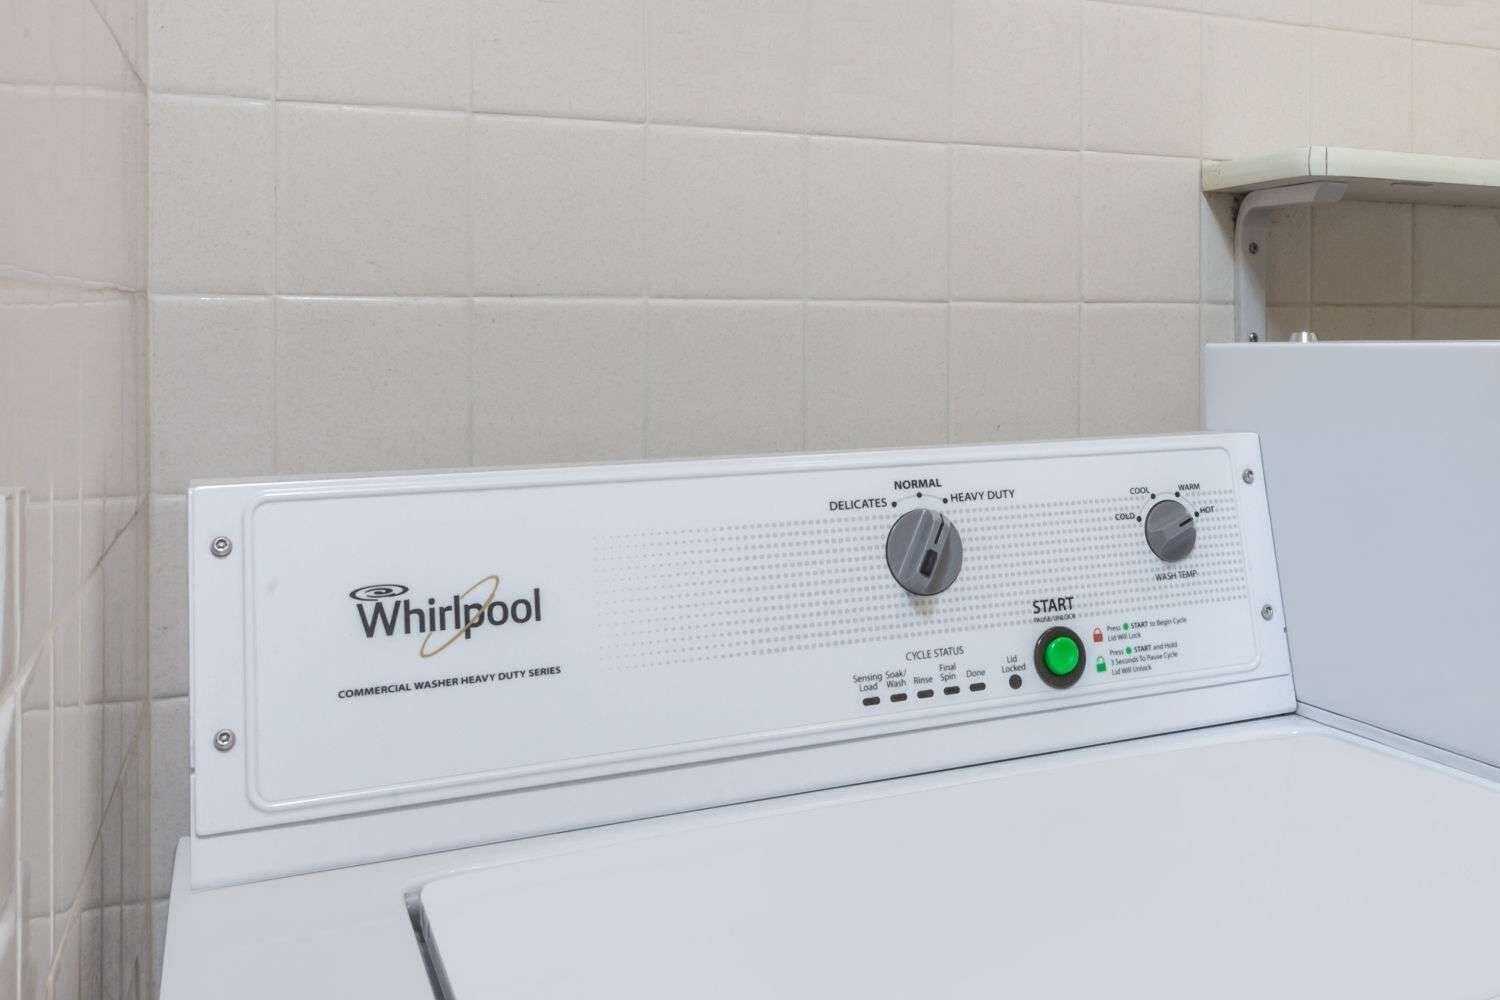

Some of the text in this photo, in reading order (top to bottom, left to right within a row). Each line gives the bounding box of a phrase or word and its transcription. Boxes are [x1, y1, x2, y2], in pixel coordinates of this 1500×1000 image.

[894, 478, 942, 490] NORMAL
[1178, 483, 1200, 491] WARM
[950, 489, 1015, 503] HEAVY DUTY
[1129, 487, 1150, 495] COOL
[829, 498, 888, 511] DELICATES
[1115, 512, 1135, 521] COLD
[1155, 571, 1177, 581] WASH
[1032, 597, 1075, 614] START
[356, 588, 542, 640] Whirlpool
[1131, 620, 1148, 630] START
[1134, 644, 1152, 653] START
[905, 646, 965, 662] CYCLE STATUS
[1006, 655, 1018, 664] Lid
[939, 662, 957, 671] Final
[1001, 663, 1026, 673] Locked
[852, 672, 883, 683] Sensing
[940, 672, 957, 683] Spin
[966, 669, 985, 678] Done
[338, 666, 561, 699] COMMERCIAL WASHER HEAVY DUTY SERIES
[886, 679, 907, 688] Wash
[913, 675, 933, 685] Rinse
[859, 682, 878, 692] Load
